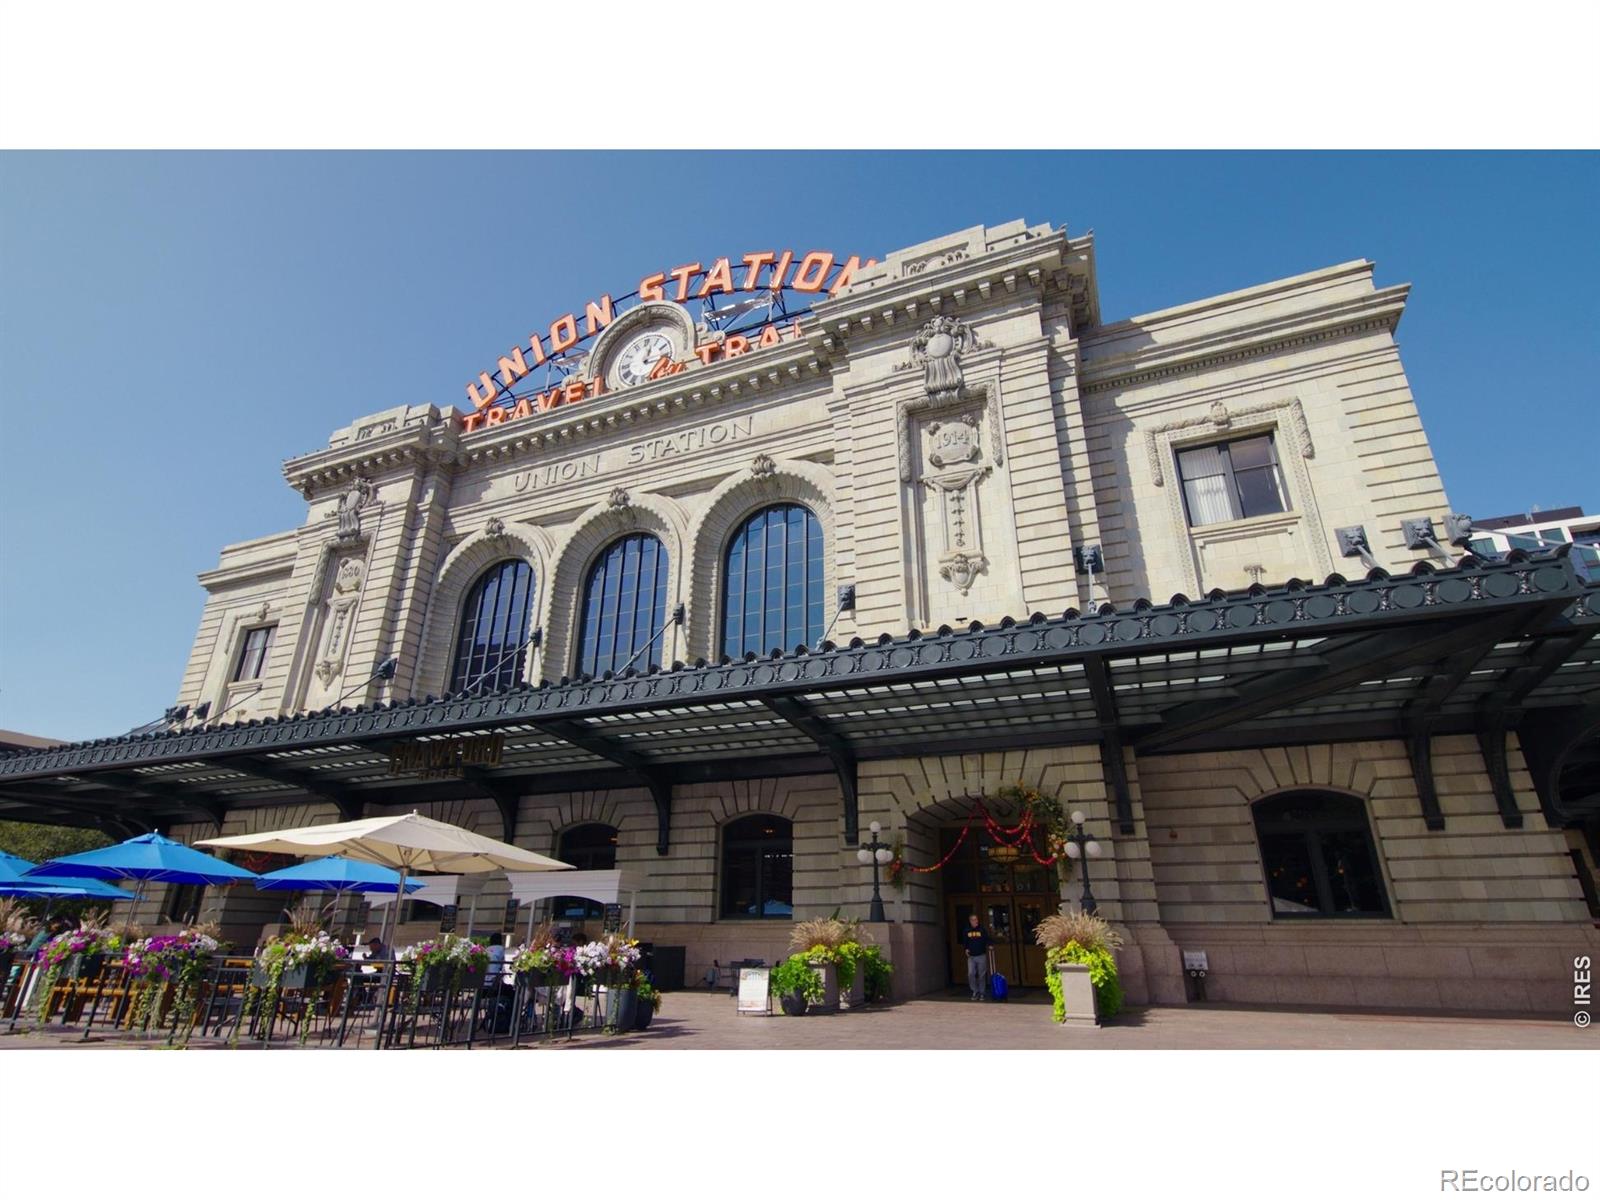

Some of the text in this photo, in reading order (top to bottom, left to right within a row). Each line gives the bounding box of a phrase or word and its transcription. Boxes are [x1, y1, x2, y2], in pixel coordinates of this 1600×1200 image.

[465, 293, 614, 411] UNION
[695, 316, 803, 366] TRAI
[513, 416, 753, 493] UNION STATION
